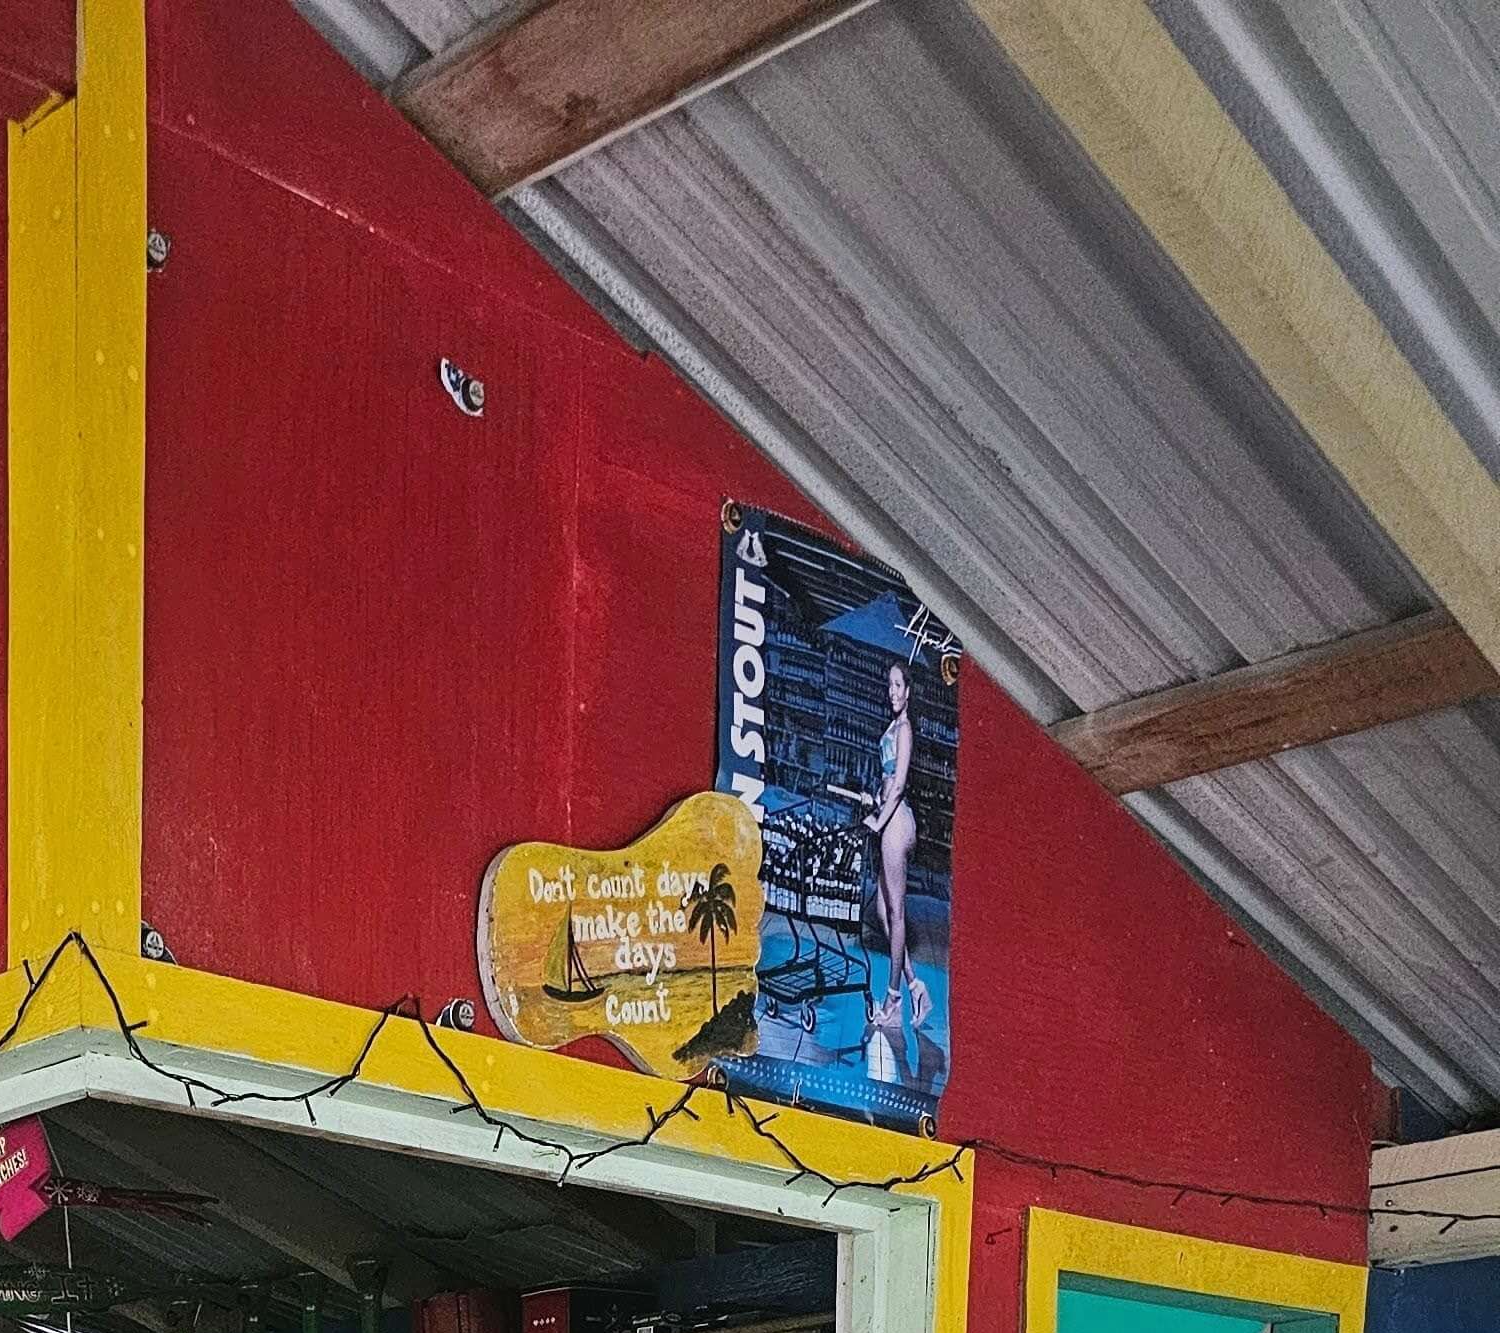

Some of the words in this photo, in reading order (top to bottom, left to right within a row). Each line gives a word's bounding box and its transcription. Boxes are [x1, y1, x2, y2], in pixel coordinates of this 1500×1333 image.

[730, 567, 767, 766] STOUT
[527, 864, 577, 904] Don't
[586, 865, 647, 900] count
[656, 860, 710, 908] days
[571, 904, 642, 942] make
[646, 900, 687, 935] the
[614, 935, 678, 986] days
[605, 982, 672, 1026] Count
